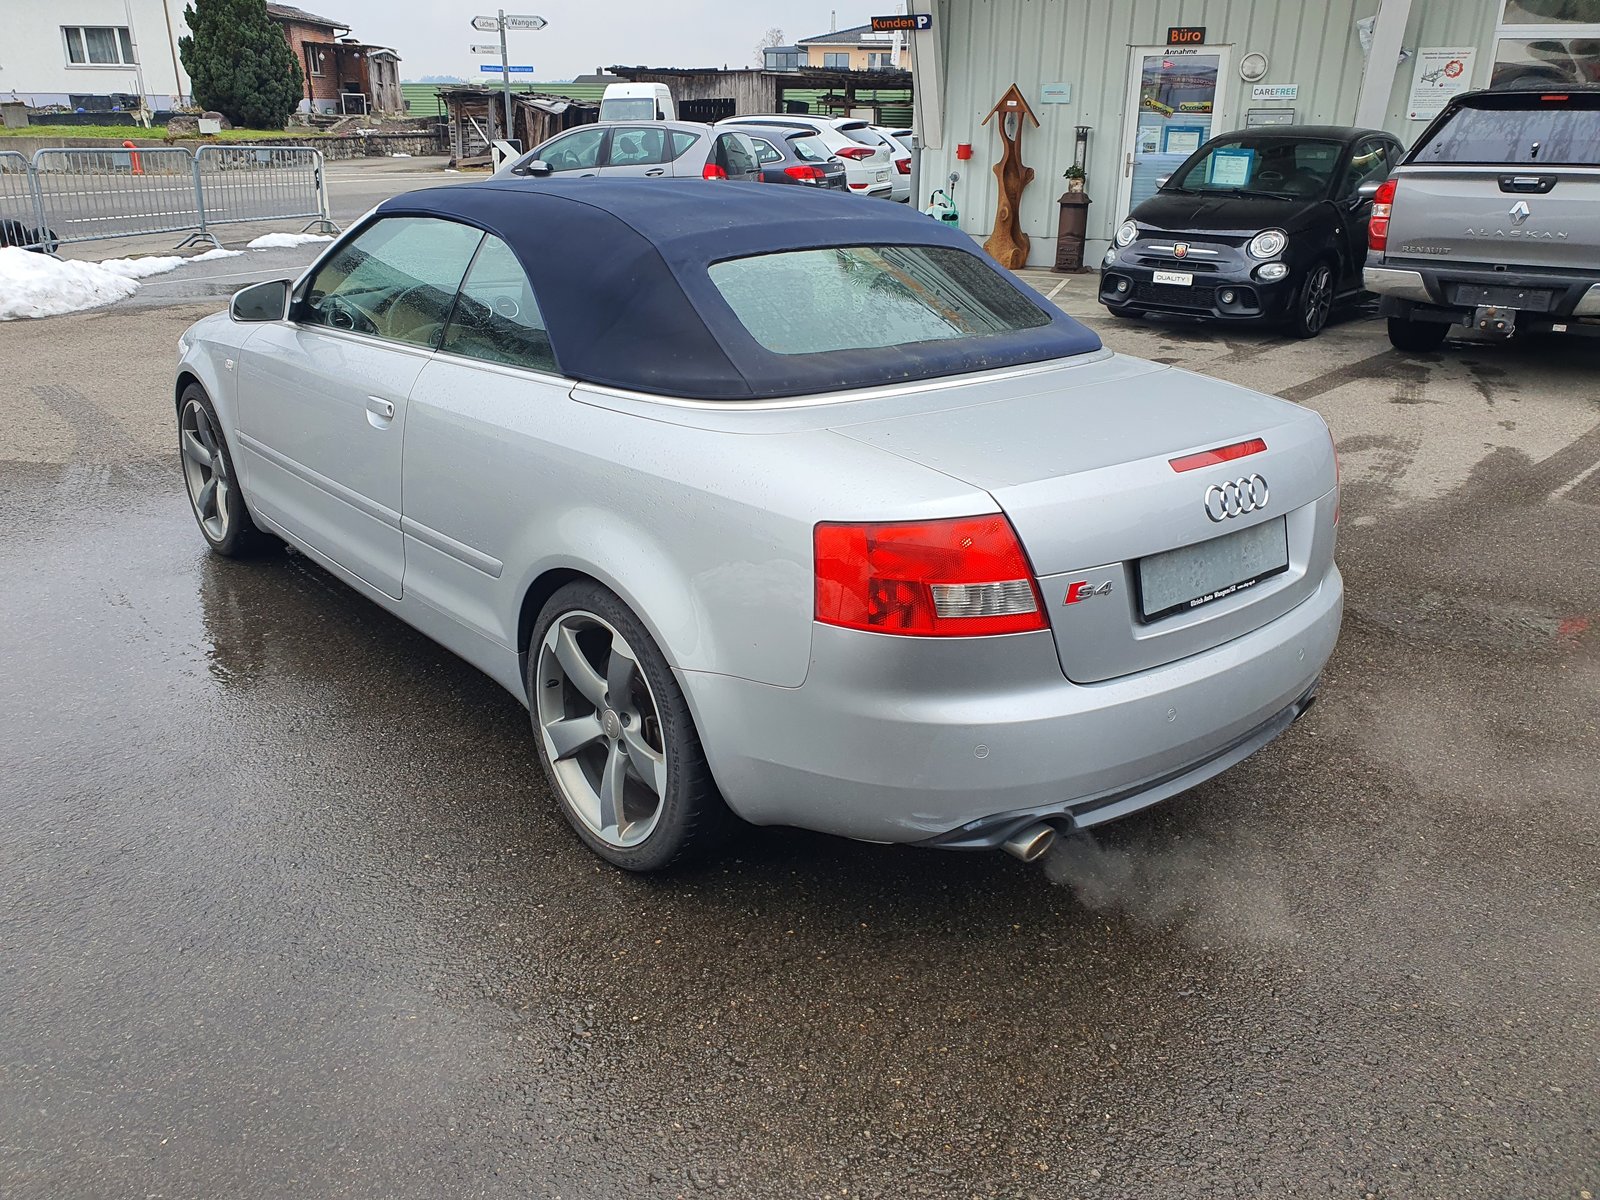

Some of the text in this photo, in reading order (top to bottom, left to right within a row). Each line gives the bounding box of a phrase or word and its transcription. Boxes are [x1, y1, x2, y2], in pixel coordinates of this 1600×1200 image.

[511, 19, 537, 27] Wangen
[873, 16, 928, 28] Kunden P
[1171, 29, 1201, 42] Büro
[1253, 88, 1297, 96] CAREFREE
[1464, 228, 1568, 240] ALASKAN
[1401, 245, 1451, 255] RENAULT
[1075, 580, 1113, 601] S4
